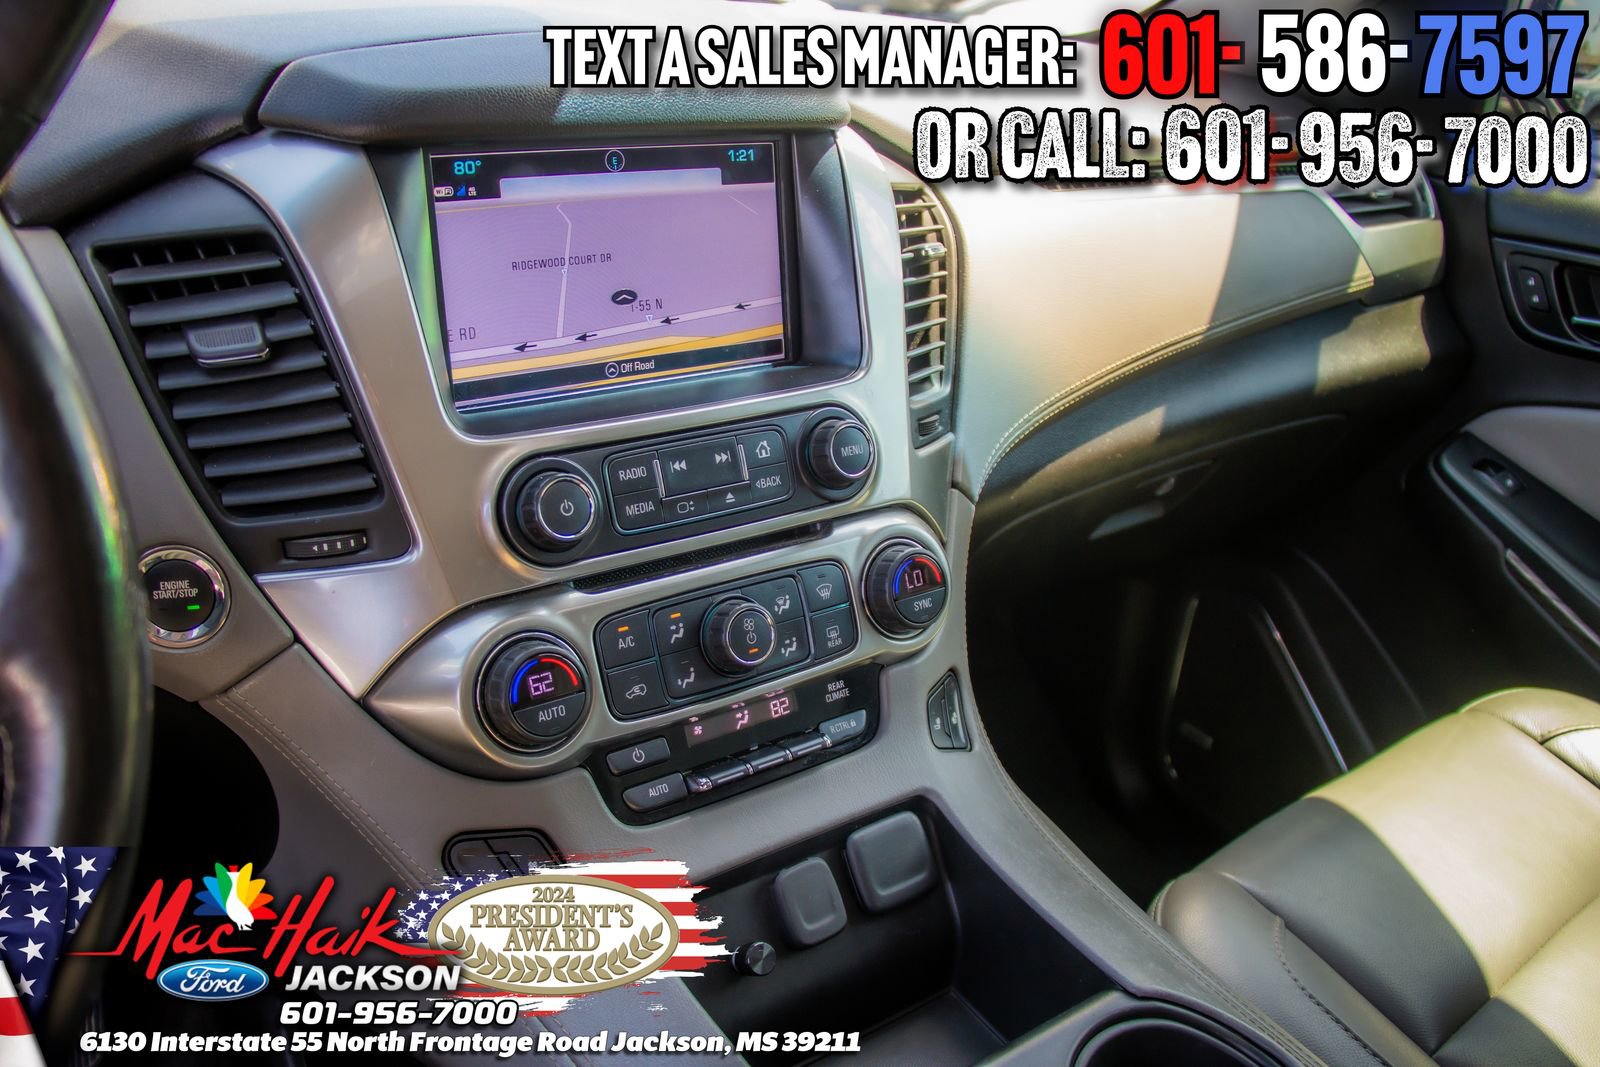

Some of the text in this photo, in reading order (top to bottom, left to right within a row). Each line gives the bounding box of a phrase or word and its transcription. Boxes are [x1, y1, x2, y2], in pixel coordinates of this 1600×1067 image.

[727, 149, 755, 162] 1:21
[453, 160, 482, 175] 80°
[511, 251, 613, 271] RIDGEWOOD COURT DR
[655, 298, 663, 309] N
[459, 326, 477, 340] RD
[620, 359, 656, 372] Off Road
[840, 443, 864, 458] MENU
[618, 465, 648, 482] RADIO
[758, 474, 783, 490] BACK
[625, 500, 655, 518] MEDIA
[160, 579, 191, 591] ENGINE
[152, 588, 199, 600] START/STOP
[913, 597, 933, 612] SYNC
[617, 635, 636, 650] A/C
[827, 637, 843, 649] REAR
[528, 671, 555, 697] 62
[827, 680, 845, 692] REAR
[825, 687, 850, 703] CLIMATE
[537, 704, 567, 723] AUTO
[769, 697, 791, 719] 82
[647, 783, 669, 799] AUTO
